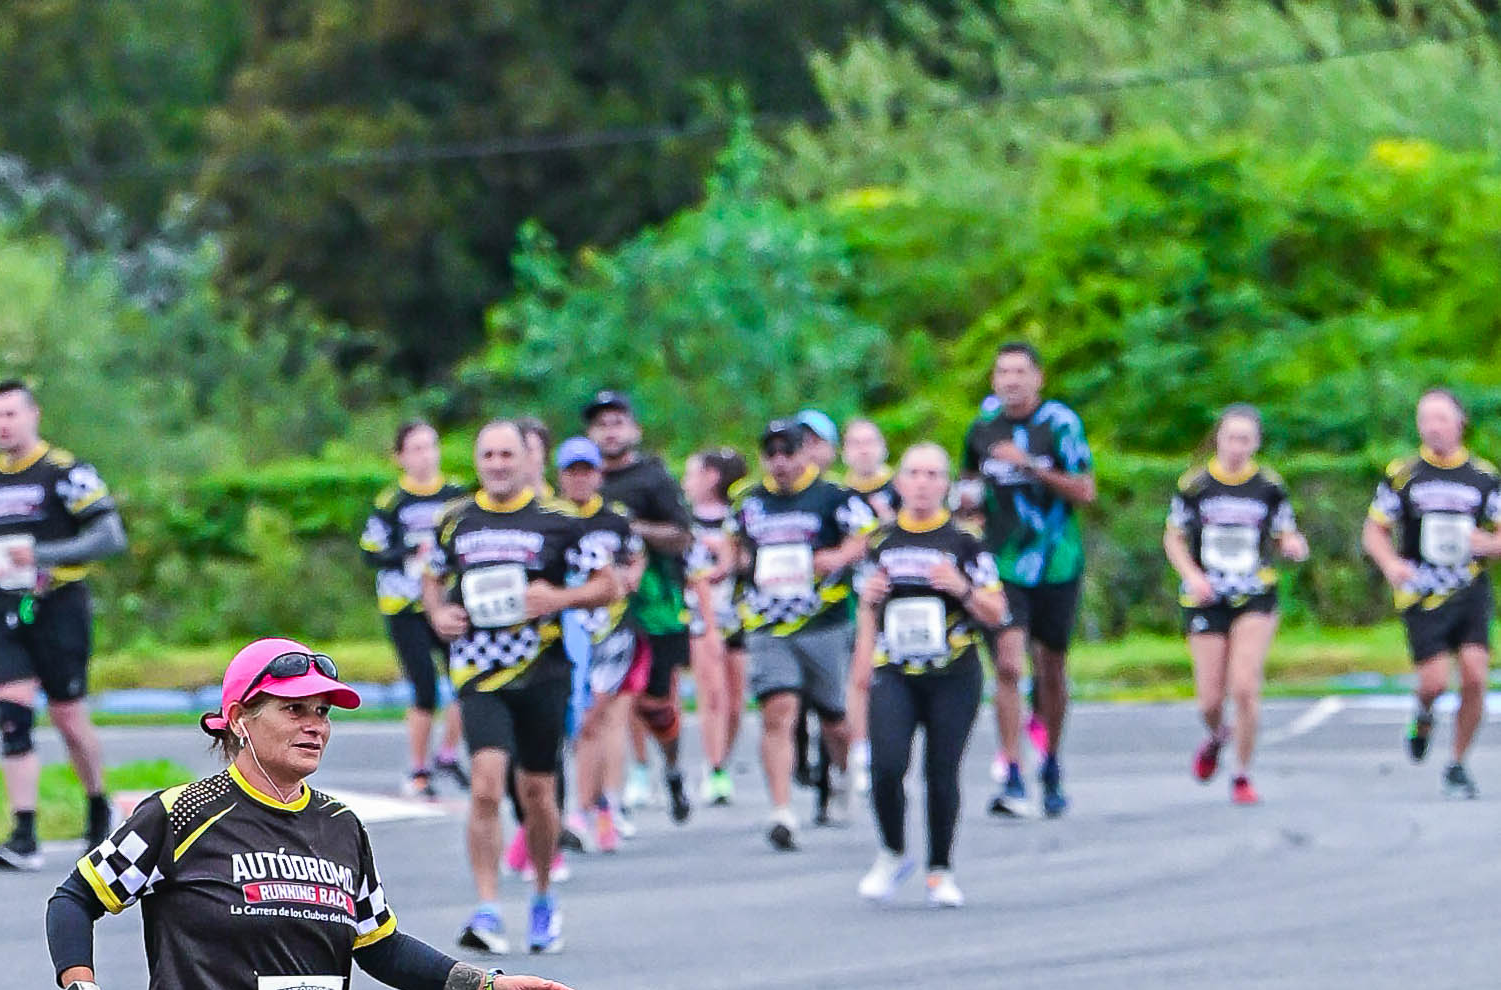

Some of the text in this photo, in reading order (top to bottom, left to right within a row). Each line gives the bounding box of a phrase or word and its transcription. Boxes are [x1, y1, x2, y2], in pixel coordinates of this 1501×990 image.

[231, 847, 356, 896] AUTÓDROMO
[258, 883, 317, 902] RUNNING
[230, 904, 243, 915] La
[243, 905, 278, 916] Carrera
[278, 906, 290, 917] de
[290, 907, 302, 918] los
[302, 909, 329, 921] Clubes
[329, 912, 343, 923] del
